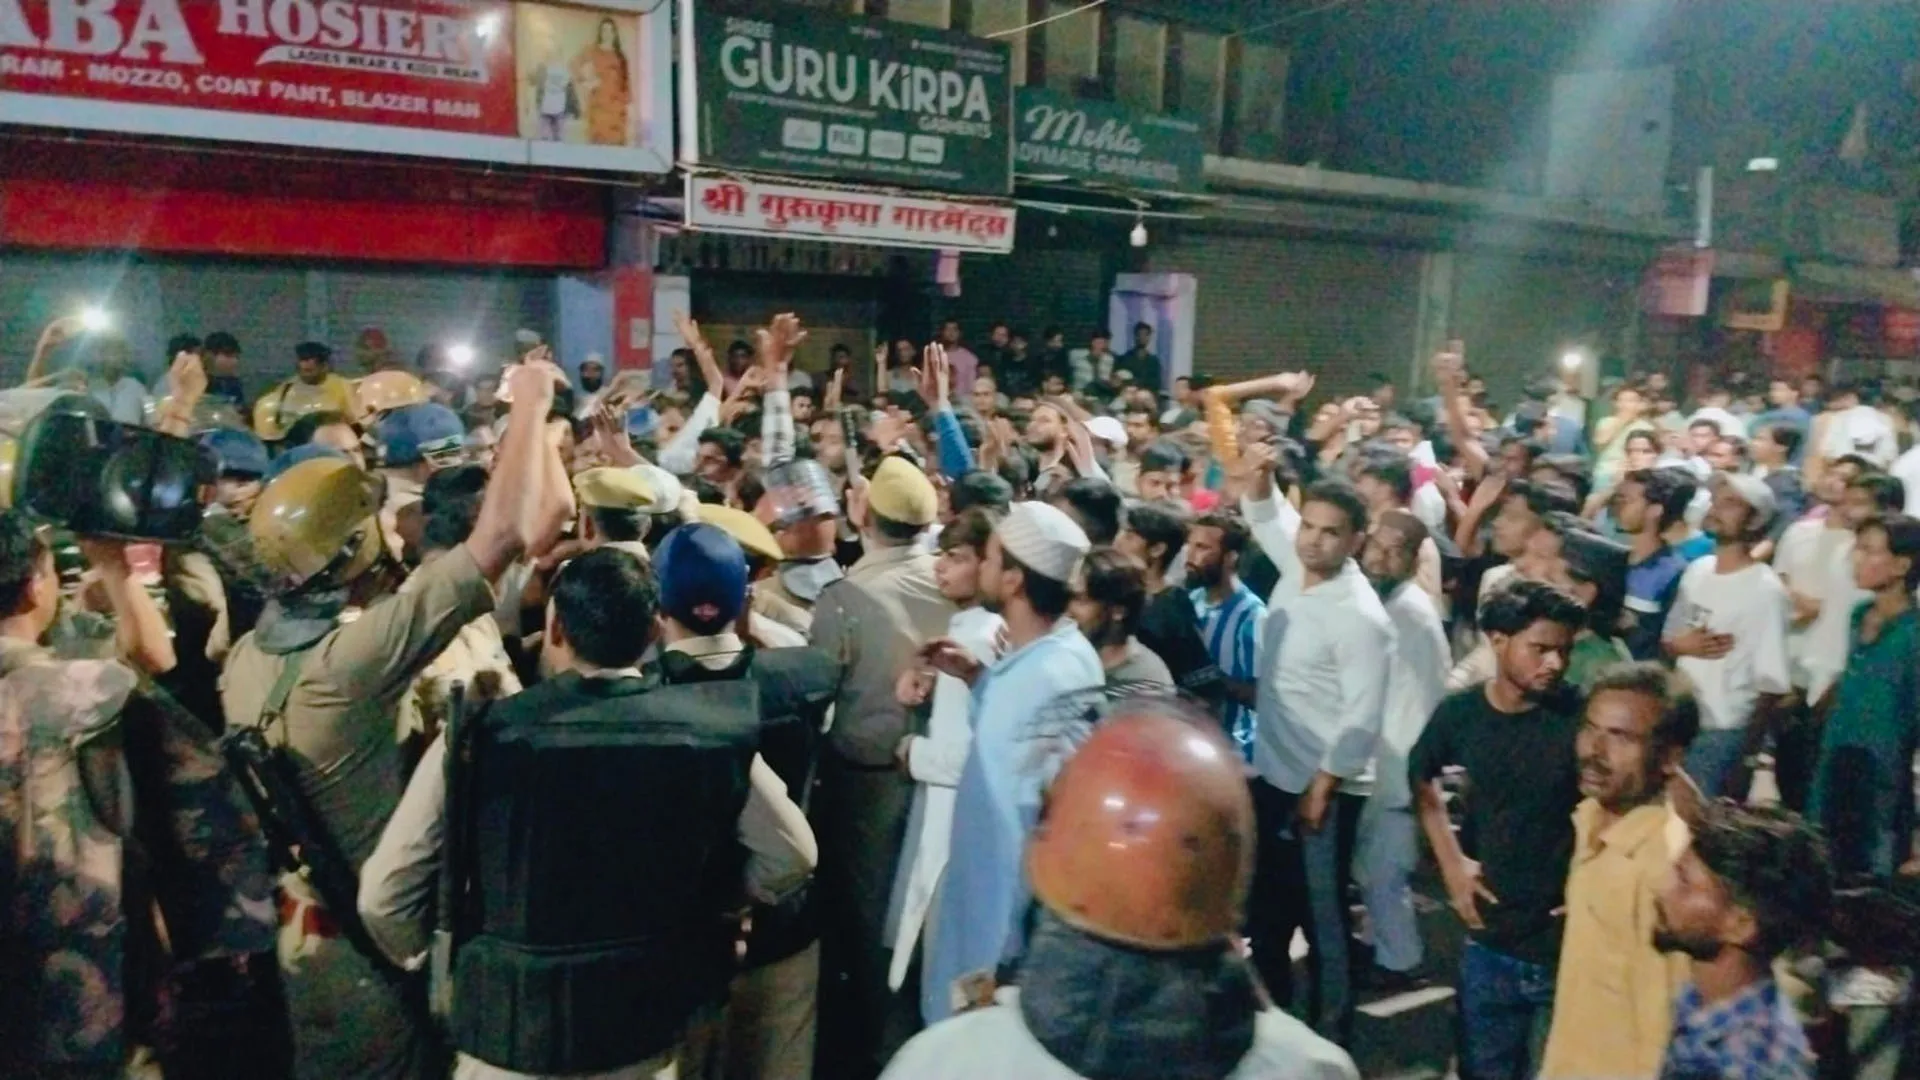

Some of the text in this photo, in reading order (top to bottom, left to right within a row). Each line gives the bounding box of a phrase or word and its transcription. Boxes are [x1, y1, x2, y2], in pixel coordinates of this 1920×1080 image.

[346, 54, 387, 69] WEAR
[720, 35, 857, 103] GURU
[88, 63, 190, 94] MOZZO,
[196, 74, 262, 97] COAT
[269, 80, 336, 108] PANT,
[340, 88, 429, 113] BLAZER
[433, 98, 480, 118] MAN
[1024, 104, 1146, 155] Mehta
[701, 183, 747, 216] श्री
